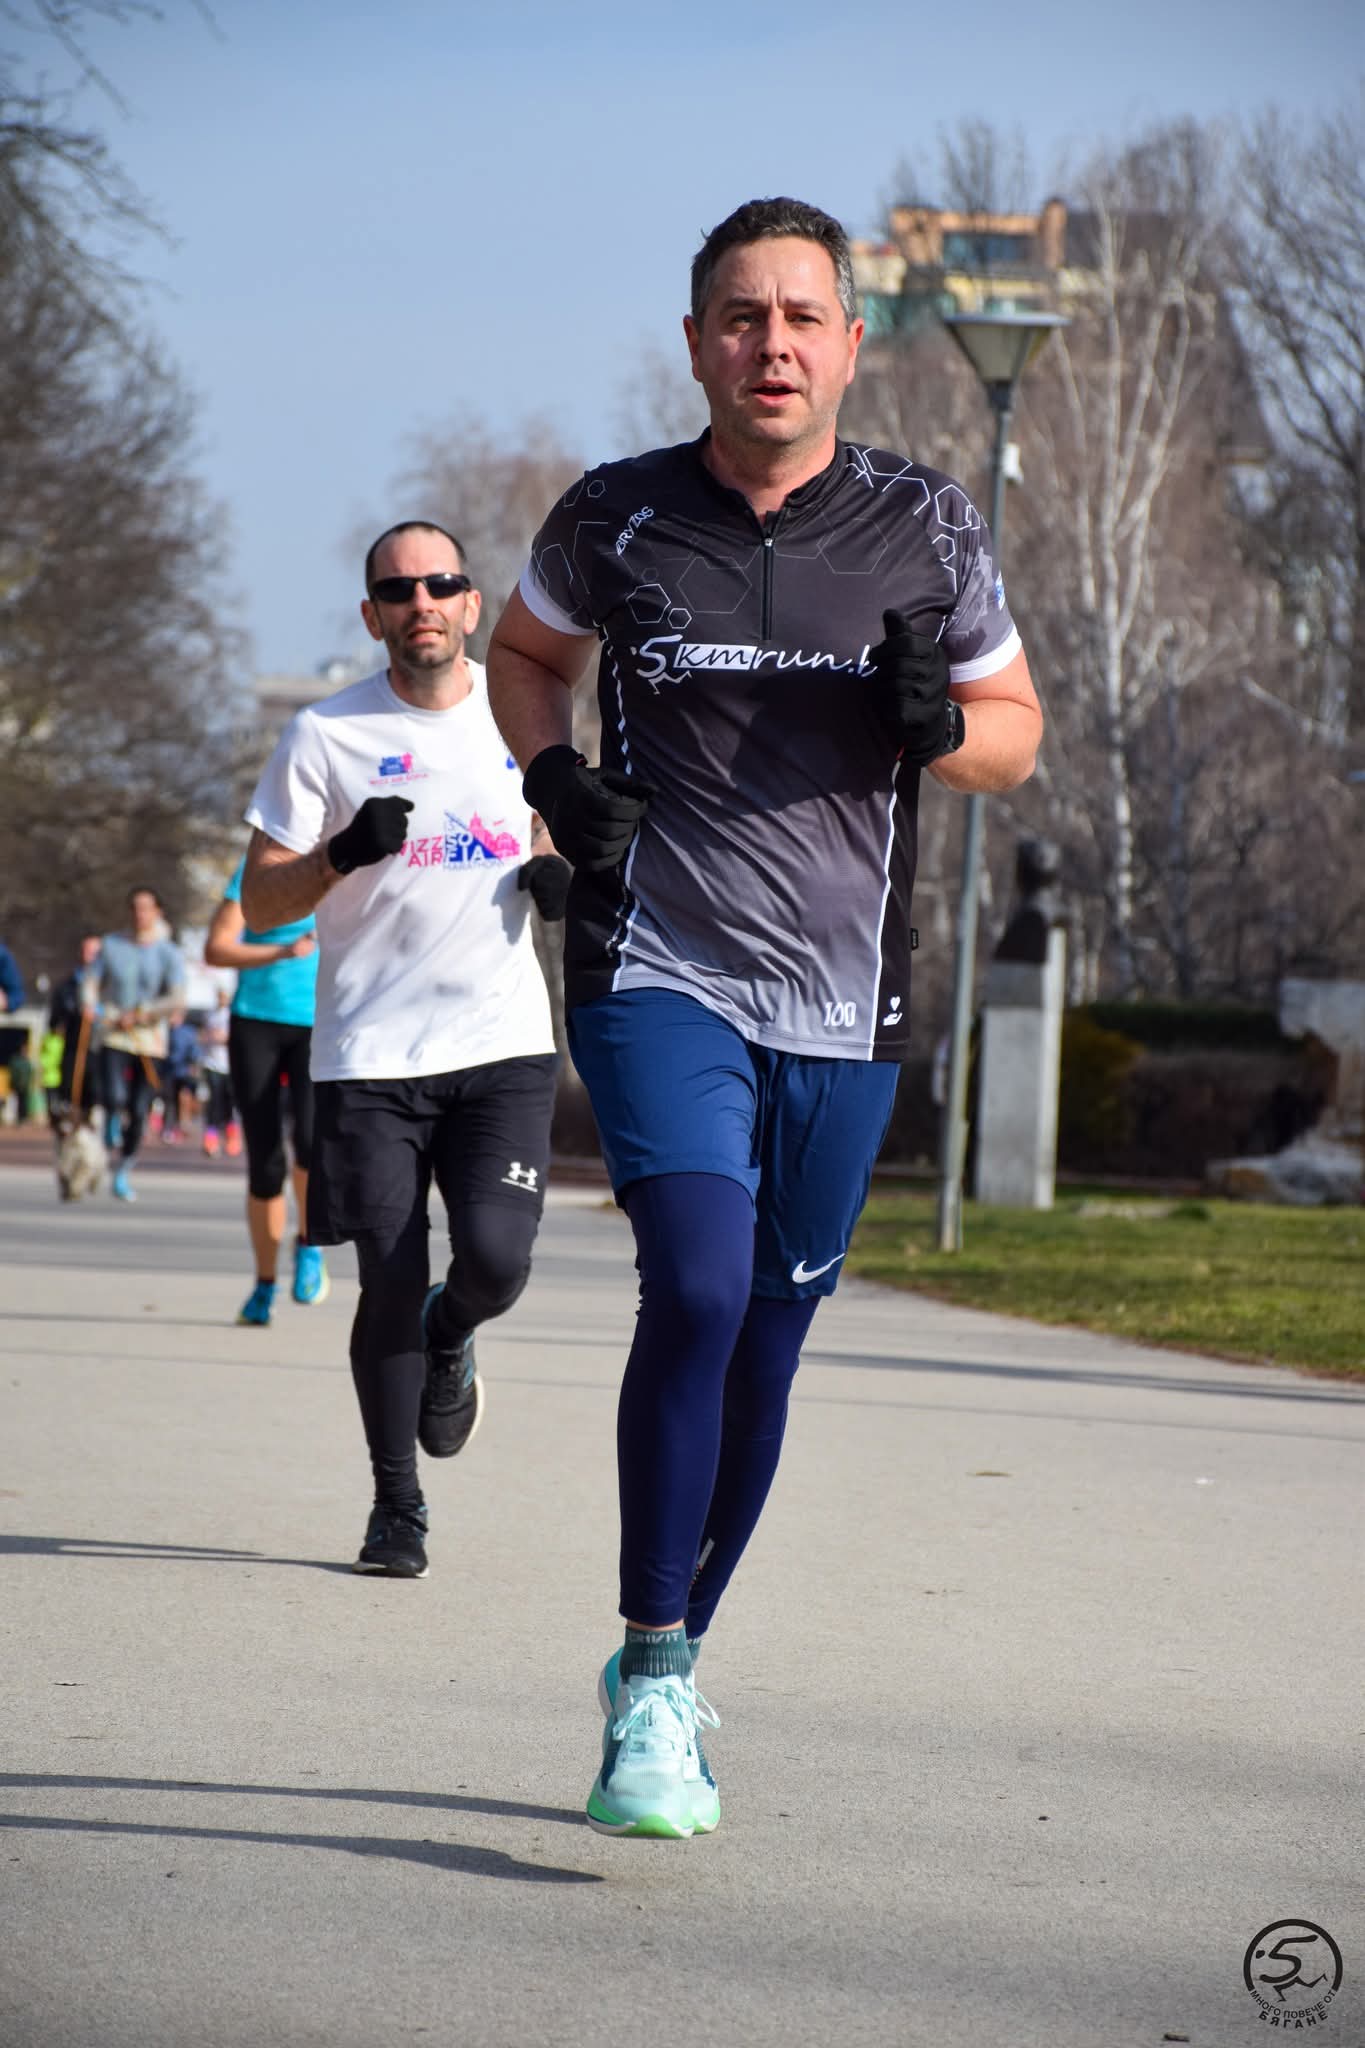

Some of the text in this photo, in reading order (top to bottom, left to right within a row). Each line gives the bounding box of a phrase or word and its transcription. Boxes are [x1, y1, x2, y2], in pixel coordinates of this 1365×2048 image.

[636, 633, 879, 679] 5kmrun.b
[407, 848, 443, 868] AIR
[823, 1001, 857, 1027] 100
